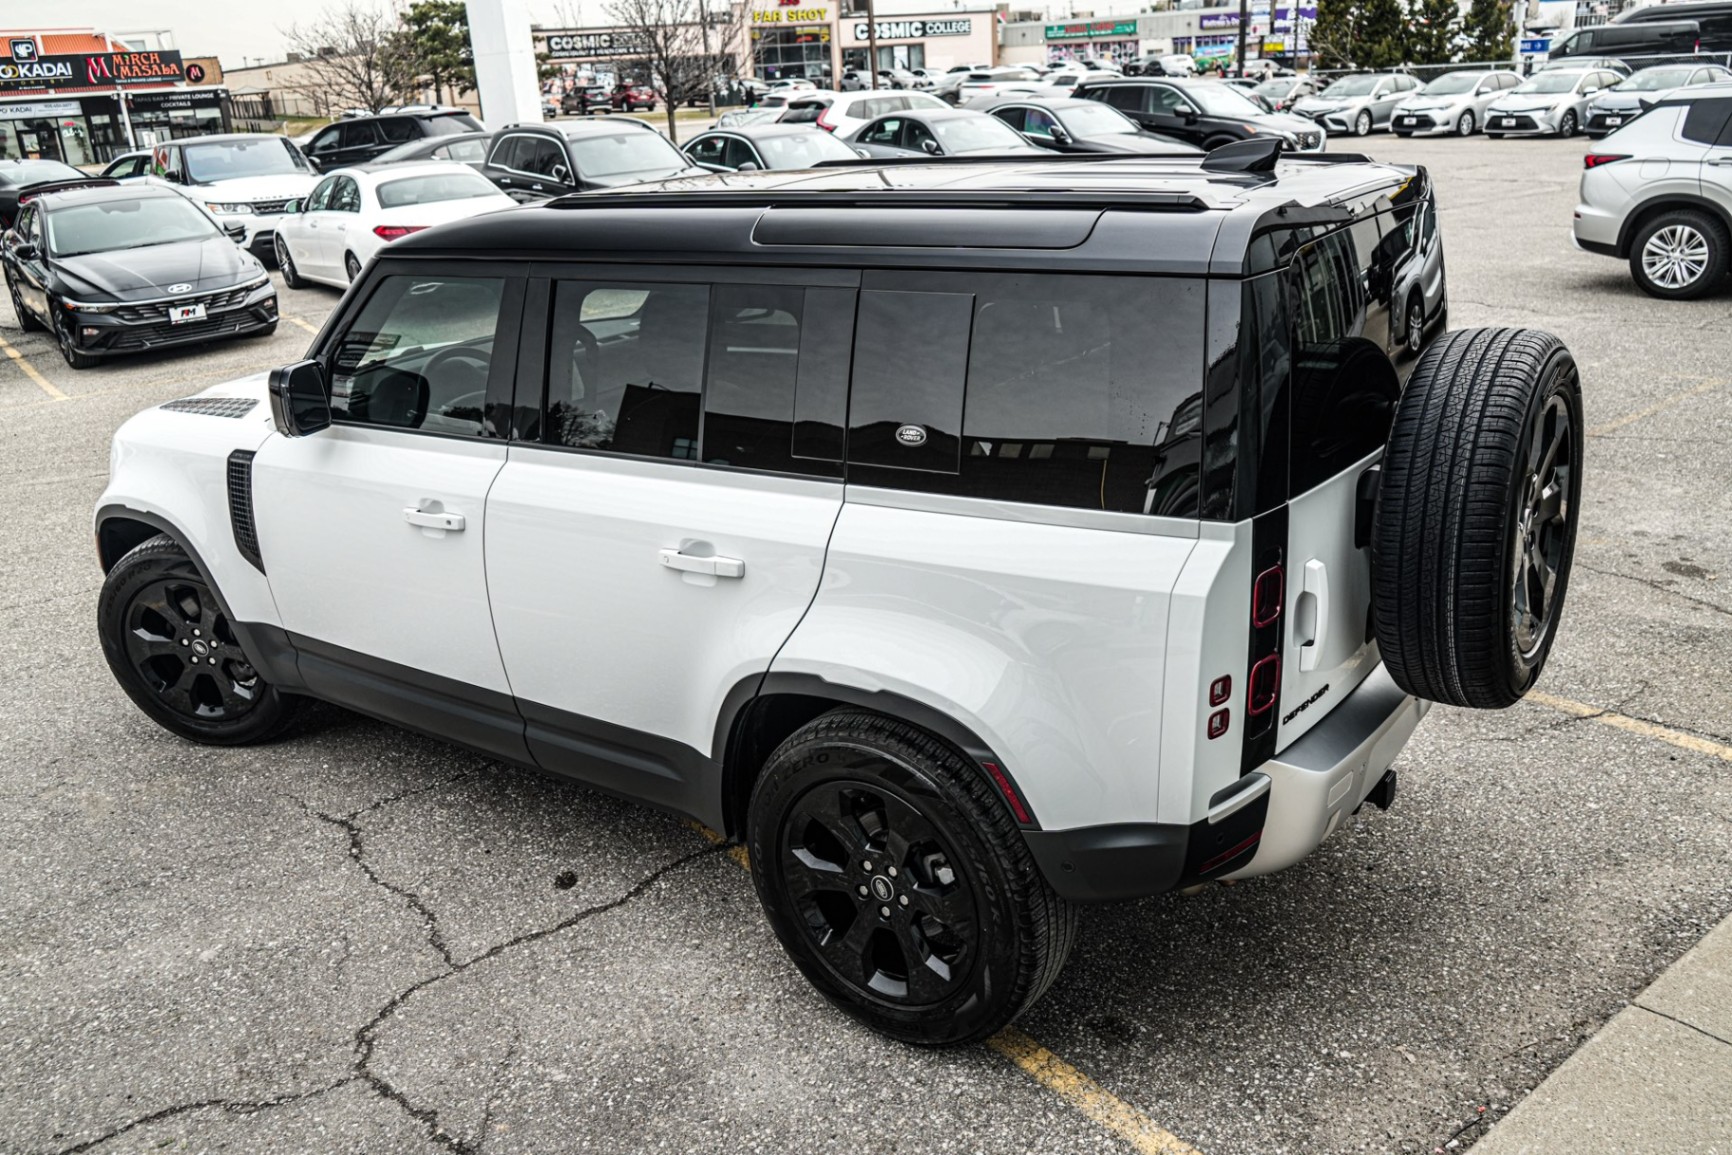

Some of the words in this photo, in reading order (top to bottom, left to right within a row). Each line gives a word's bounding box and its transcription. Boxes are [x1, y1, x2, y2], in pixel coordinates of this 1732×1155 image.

[752, 9, 782, 22] FAR
[786, 8, 826, 21] SHOT
[925, 21, 971, 34] COLLEGE
[550, 34, 611, 50] COSMIC
[112, 52, 160, 76] MIRCH
[120, 63, 180, 79] MASALA
[160, 100, 191, 108] COCKTAILS
[1282, 683, 1330, 726] DEFENDER
